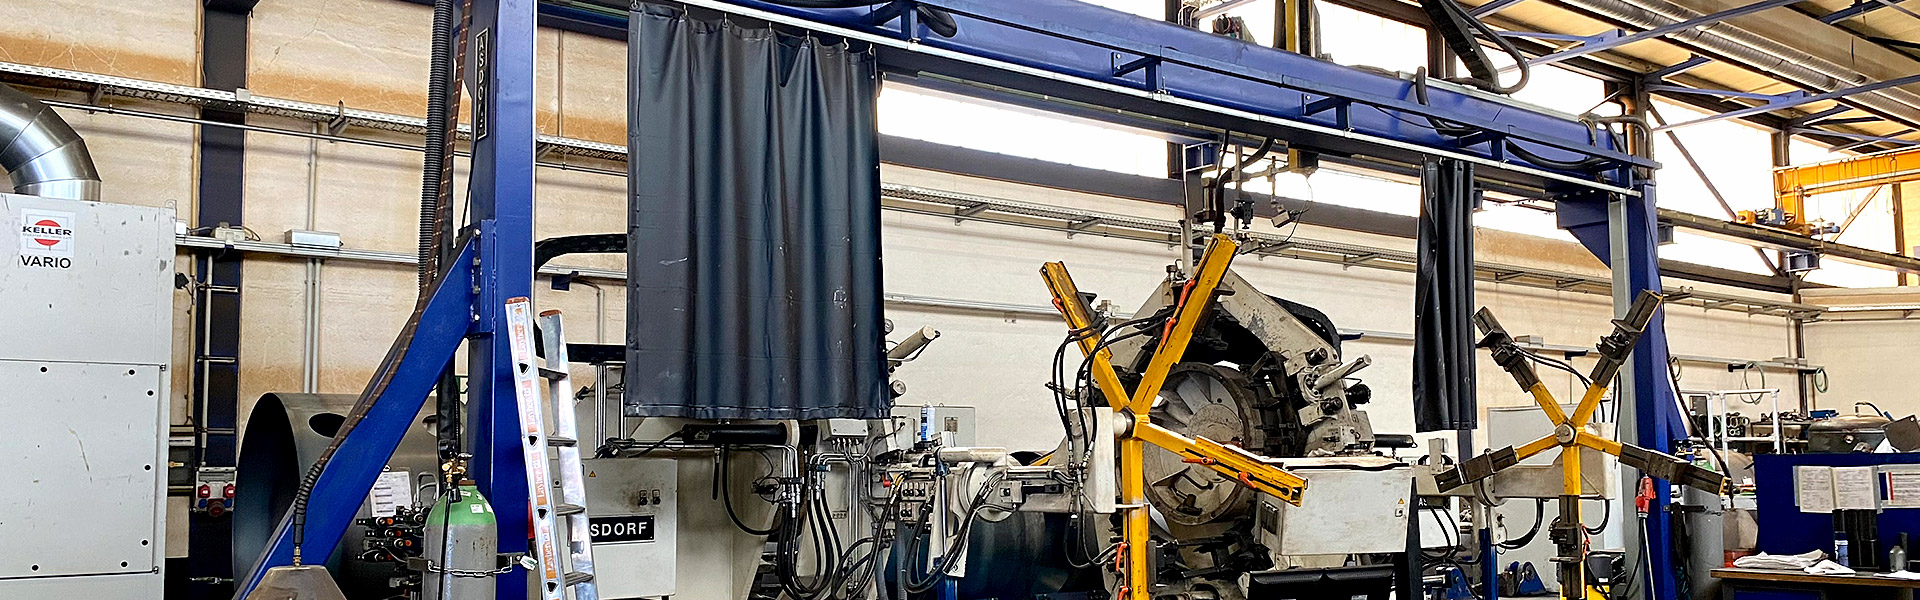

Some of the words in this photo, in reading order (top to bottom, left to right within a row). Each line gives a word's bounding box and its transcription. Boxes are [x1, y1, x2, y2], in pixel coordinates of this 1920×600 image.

[22, 226, 72, 236] KELLER
[21, 255, 71, 268] VARIO
[590, 522, 647, 537] SDORF
